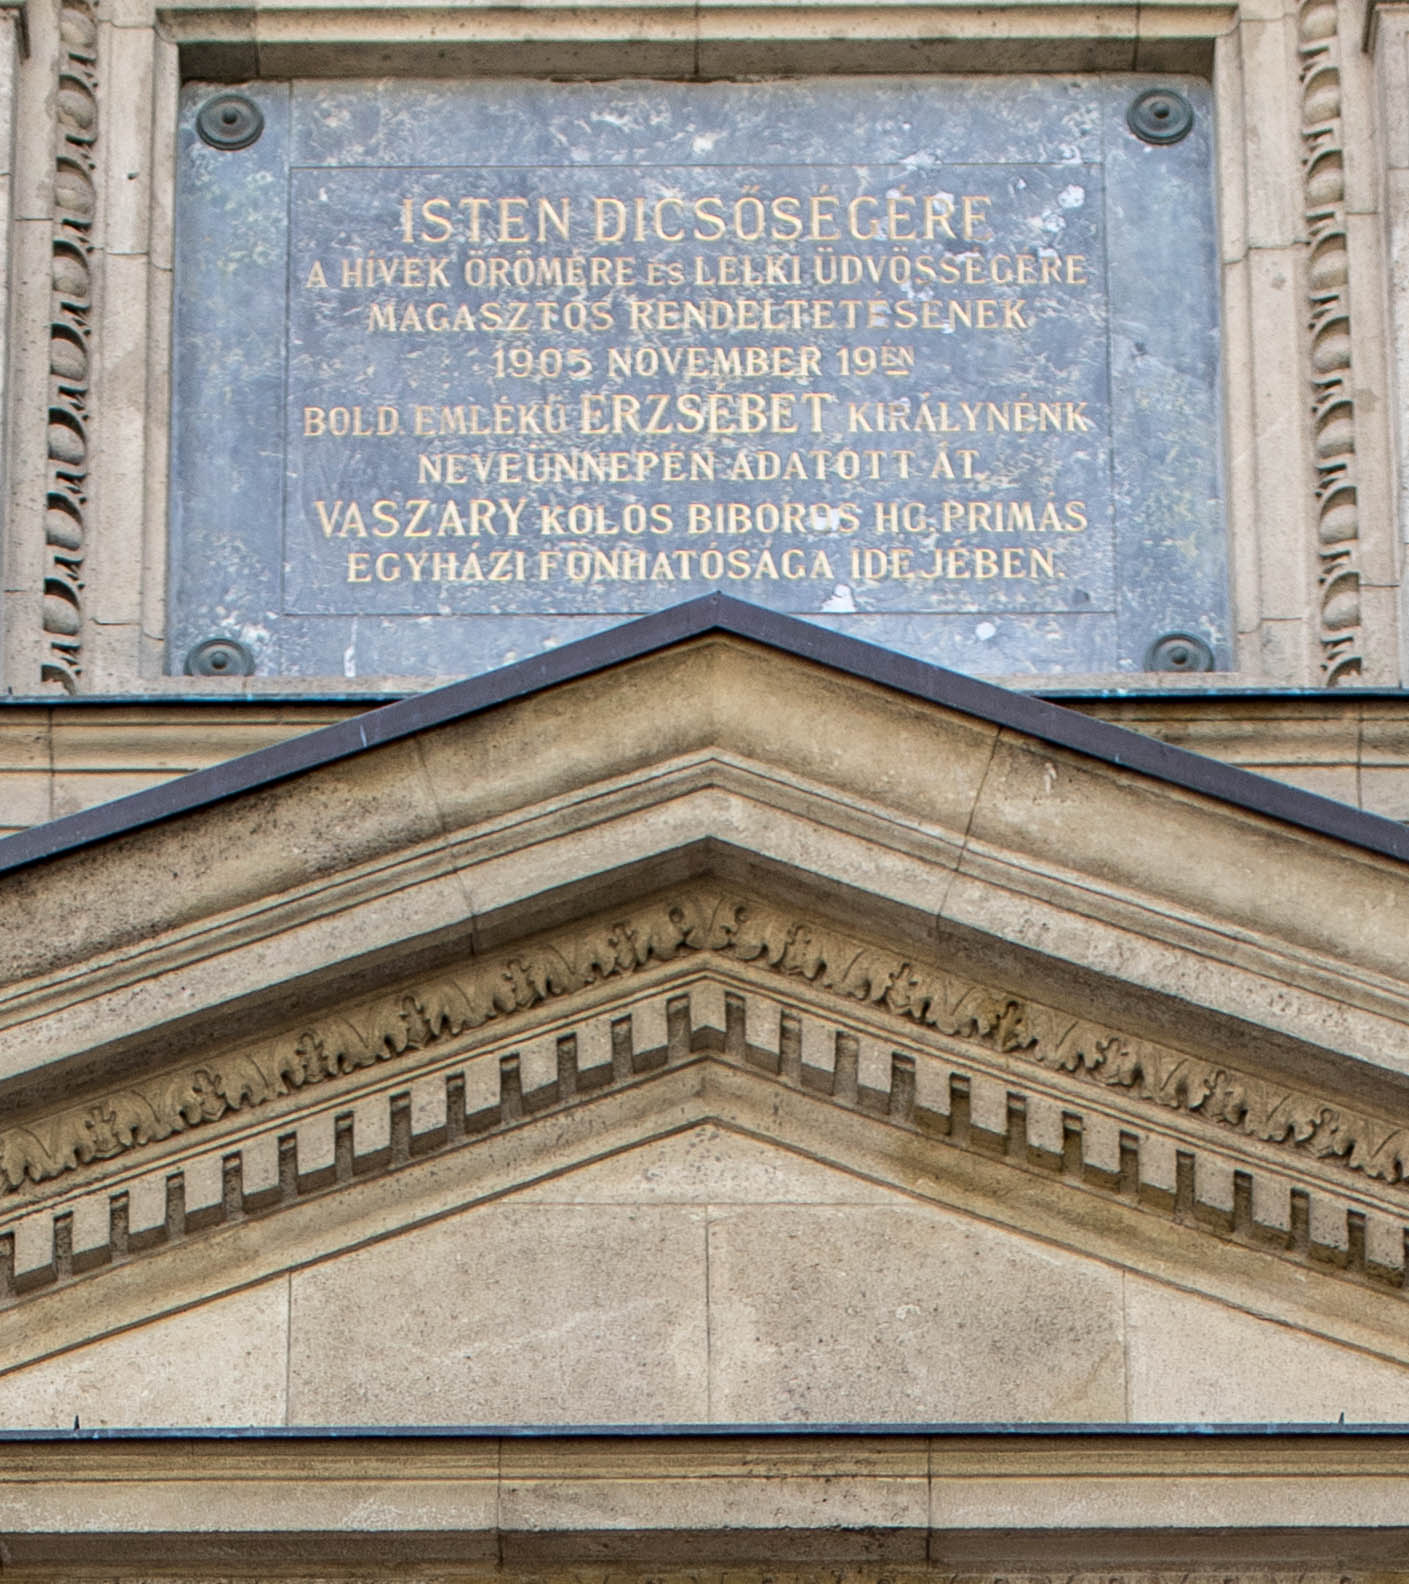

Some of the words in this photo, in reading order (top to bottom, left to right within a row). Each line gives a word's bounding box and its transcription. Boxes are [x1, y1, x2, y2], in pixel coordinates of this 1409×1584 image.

[401, 197, 571, 243] ISTEN
[594, 185, 993, 243] DICSŐSÉGÉRE
[306, 260, 329, 288] A
[341, 250, 452, 288] HÍVEK
[694, 255, 802, 286] LELKI
[814, 247, 1089, 286] ÜDVÖSSÉGÉRE
[367, 301, 615, 333] MAGASZTOS
[494, 347, 593, 379] 1905
[608, 346, 823, 378] NOVEMBER
[303, 406, 405, 437] BOLD.
[848, 392, 1089, 432] KIRÁLYNÉNK
[731, 450, 917, 480] ADATOTT
[316, 498, 528, 539] VASZARY
[538, 502, 674, 536] KOLOS
[347, 542, 525, 583] EGYHÁZI
[851, 539, 1066, 580] IDEJÉBEN.
